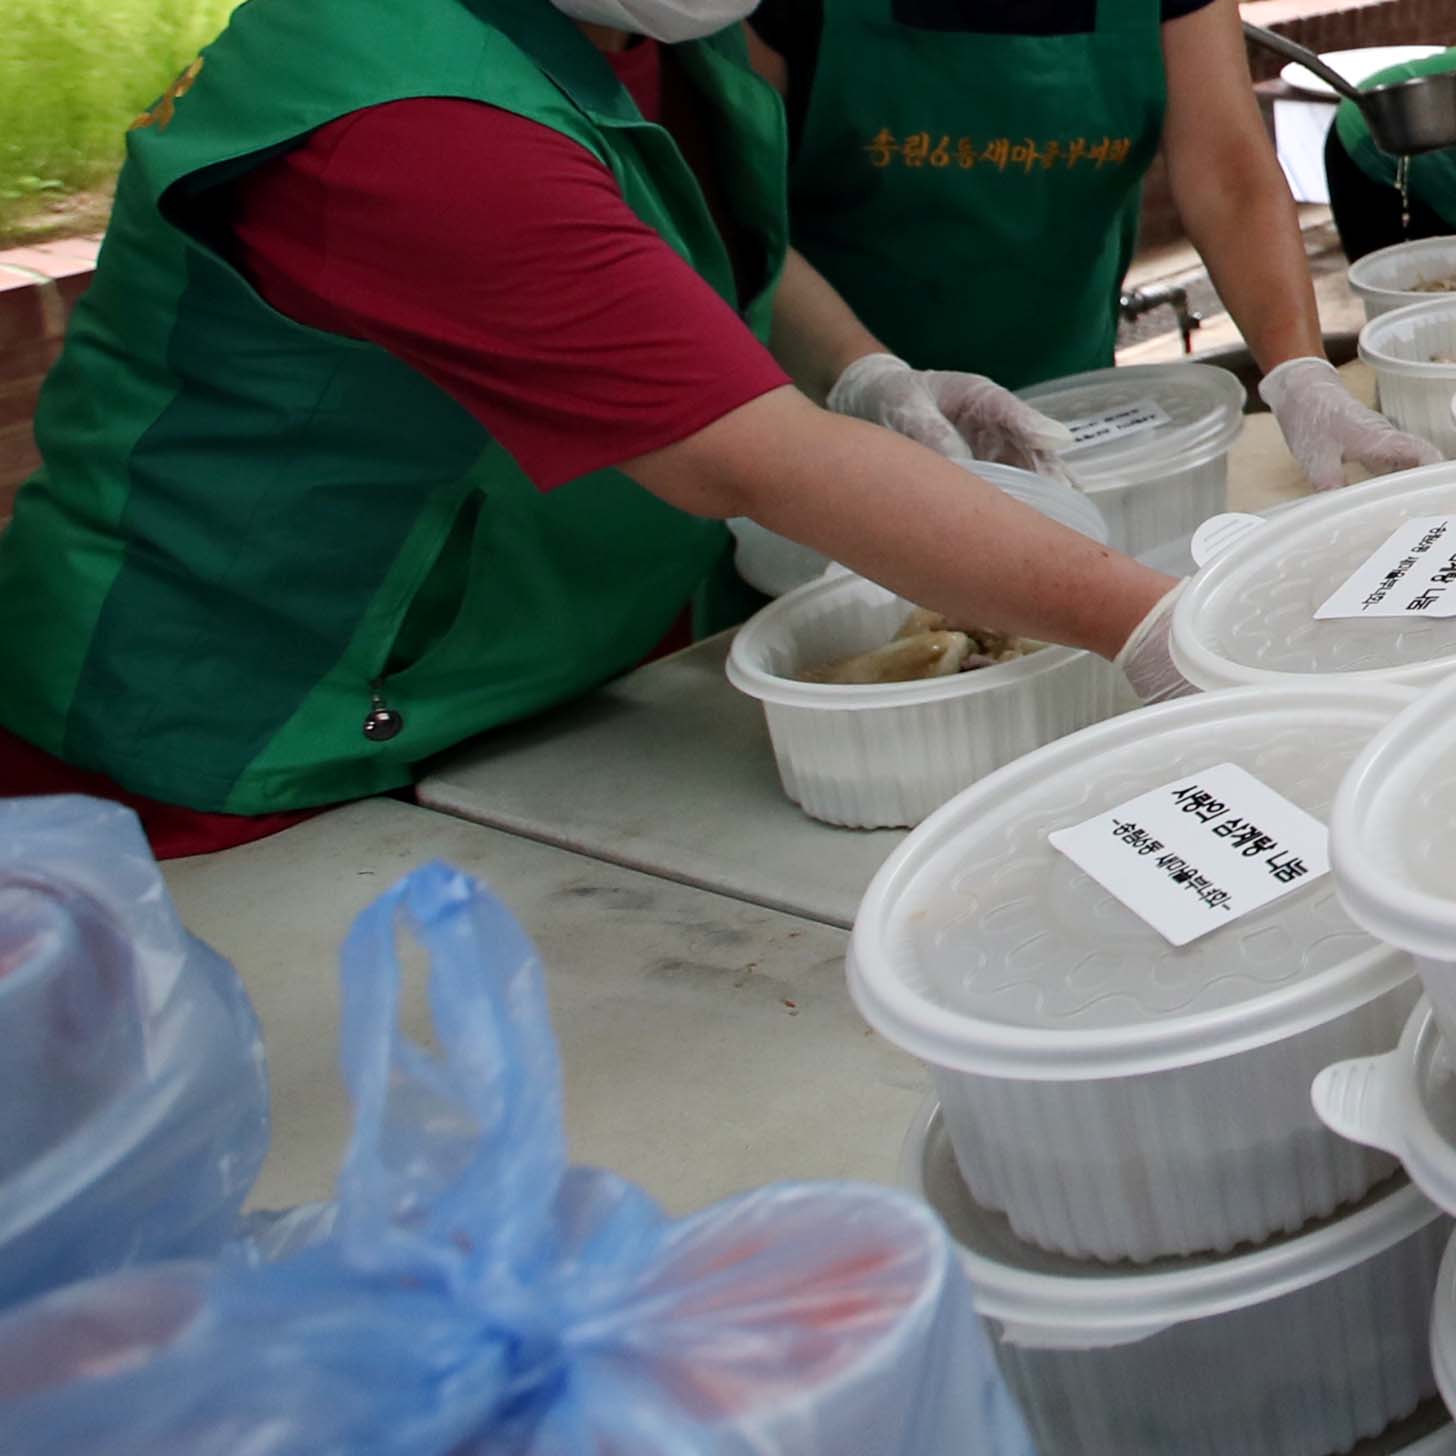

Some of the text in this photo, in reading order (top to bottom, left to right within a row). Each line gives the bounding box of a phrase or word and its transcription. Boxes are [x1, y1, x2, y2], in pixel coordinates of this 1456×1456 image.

[1405, 588, 1447, 611] 나눔
[1171, 785, 1309, 884] 사랑의 삼계탕 나눔
